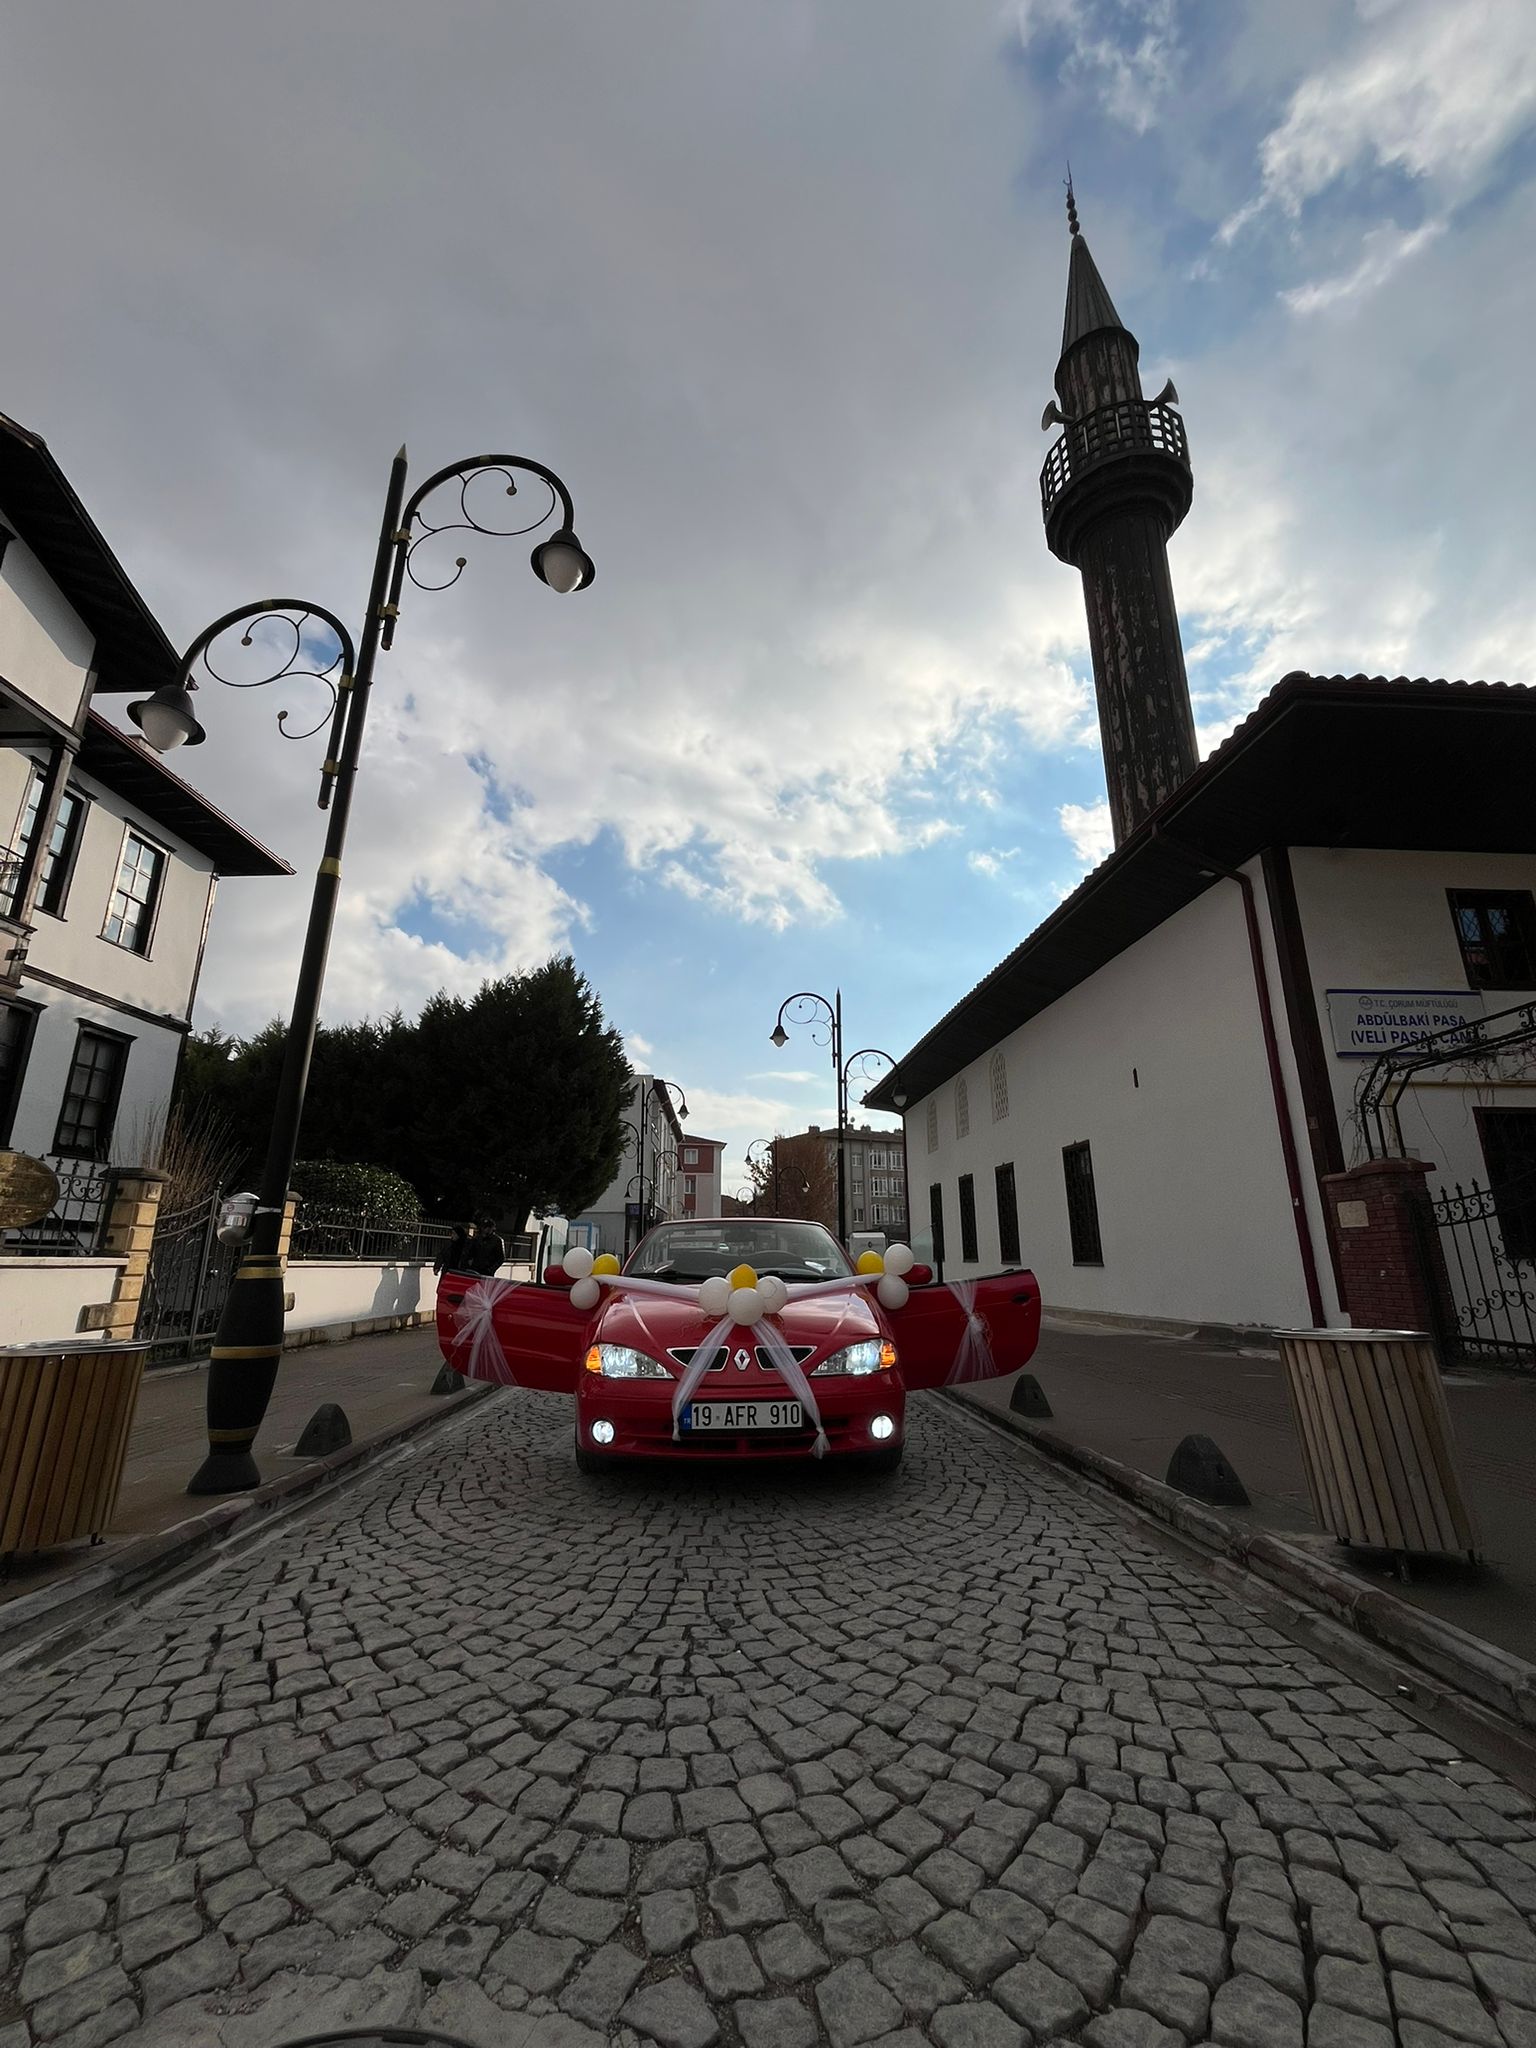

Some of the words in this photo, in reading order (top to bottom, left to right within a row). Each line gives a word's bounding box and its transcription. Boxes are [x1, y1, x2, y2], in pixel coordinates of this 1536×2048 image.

[1388, 1000, 1415, 1009] ÇORUM
[1357, 1012, 1430, 1026] ABDÜLBAKİ
[1351, 1027, 1387, 1045] (VELİ
[1440, 1031, 1476, 1044] CAM
[693, 1406, 712, 1426] 19
[724, 1404, 758, 1426] AFR
[769, 1403, 801, 1425] 910
